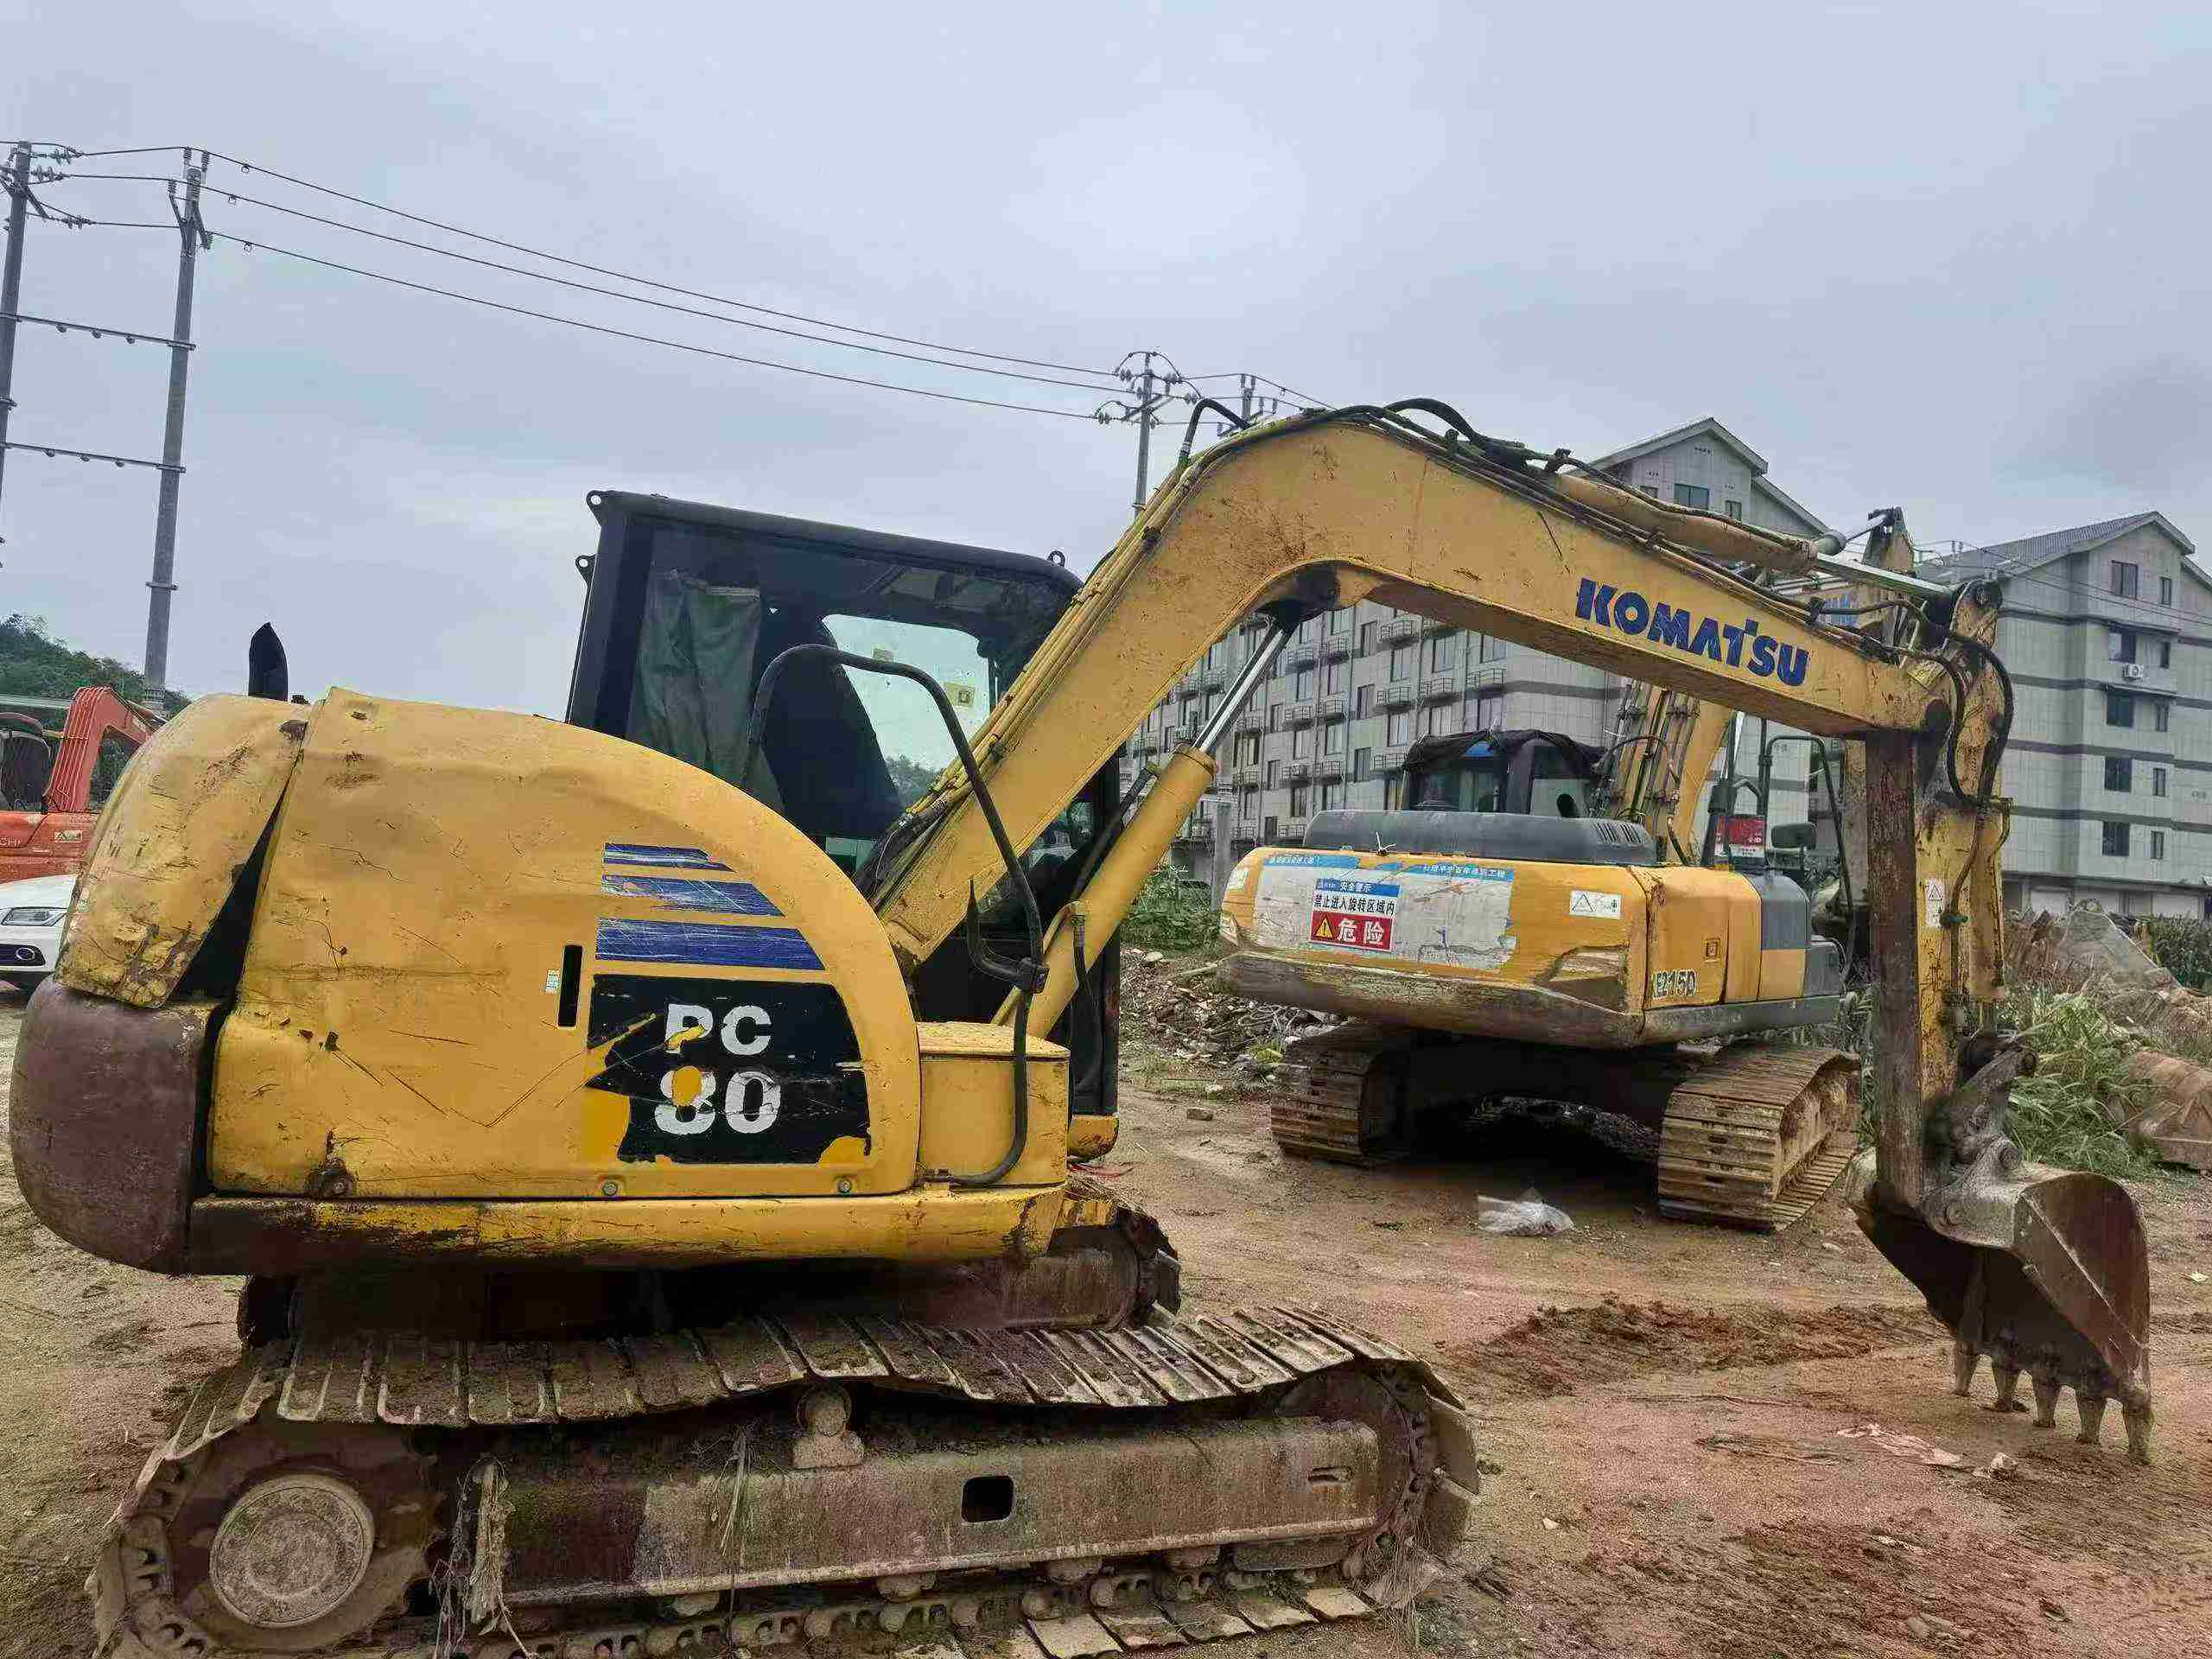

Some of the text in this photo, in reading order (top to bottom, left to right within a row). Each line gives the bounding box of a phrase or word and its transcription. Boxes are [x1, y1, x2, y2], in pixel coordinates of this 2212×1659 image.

[1575, 577, 1809, 687] KOMATSU
[1313, 893, 1395, 916] 禁止进入旋转区域内
[1341, 880, 1372, 893] 安全警示
[1337, 918, 1385, 945] 危险
[665, 1002, 772, 1055] PC
[654, 1070, 781, 1135] 80
